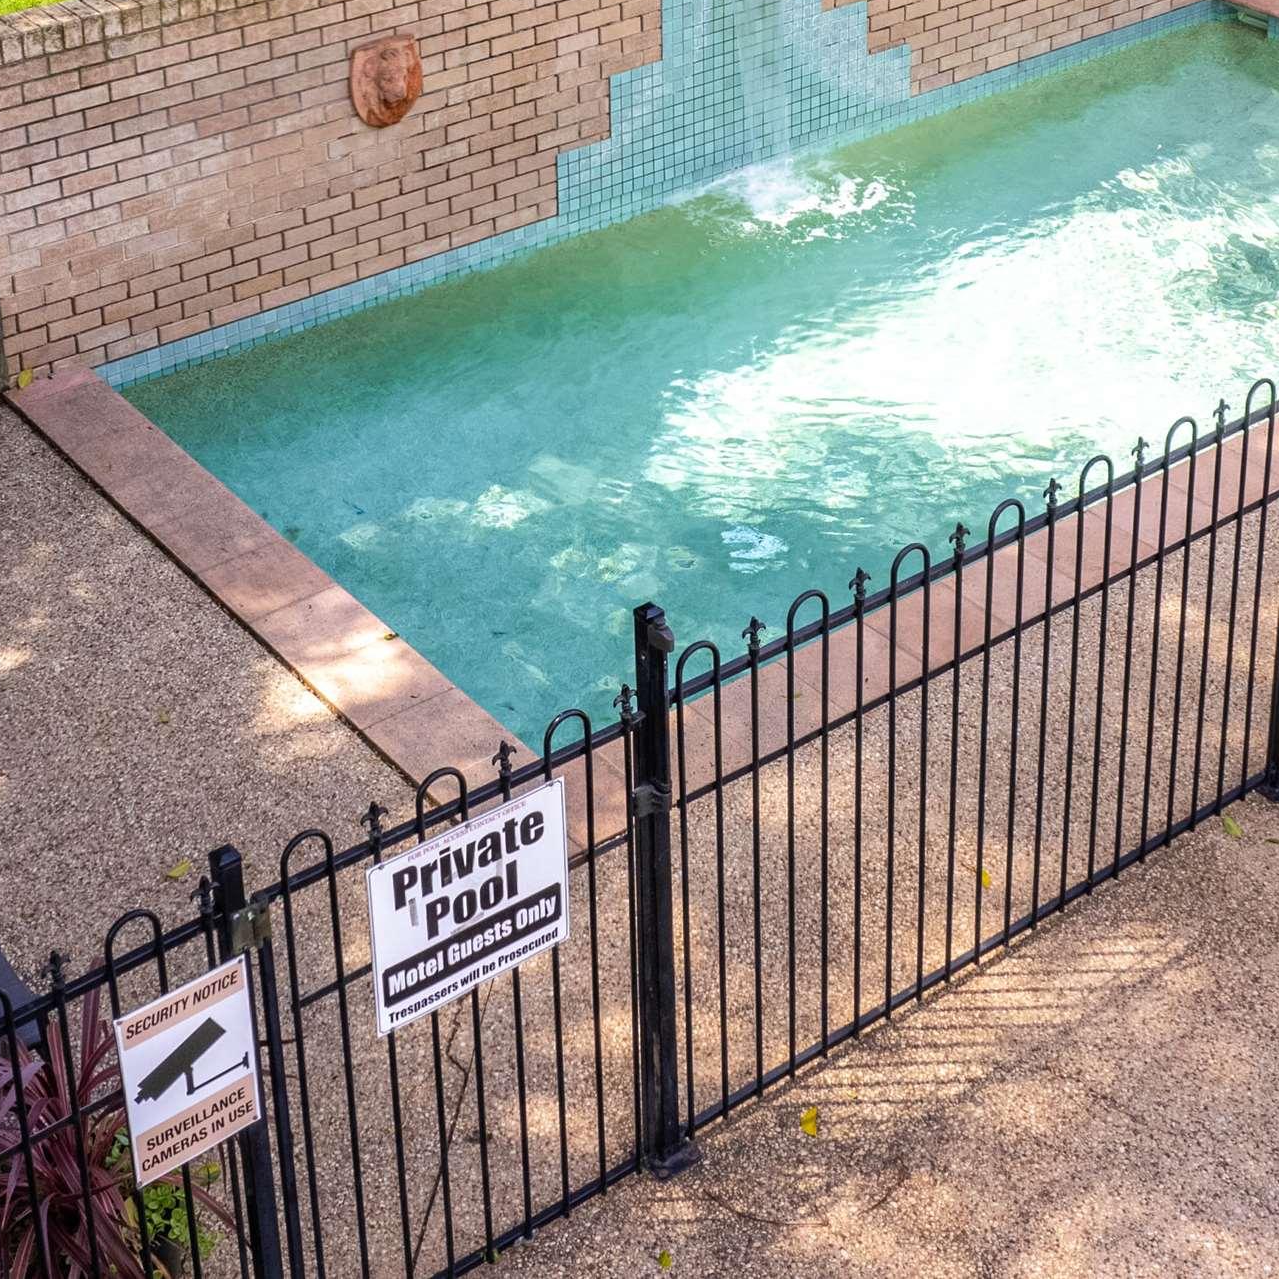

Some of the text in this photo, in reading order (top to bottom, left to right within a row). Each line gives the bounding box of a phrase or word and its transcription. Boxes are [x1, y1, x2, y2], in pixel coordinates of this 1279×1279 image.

[392, 810, 544, 911] Private
[425, 859, 519, 940] Pool
[388, 895, 557, 997] Motel Guests Only
[388, 927, 559, 1023] Trespassers will be Prosecuted
[126, 970, 238, 1040] SECURITY NOTICE
[142, 1100, 254, 1173] CAMERAS IN USE
[146, 1087, 246, 1152] SURVEILLANCE
